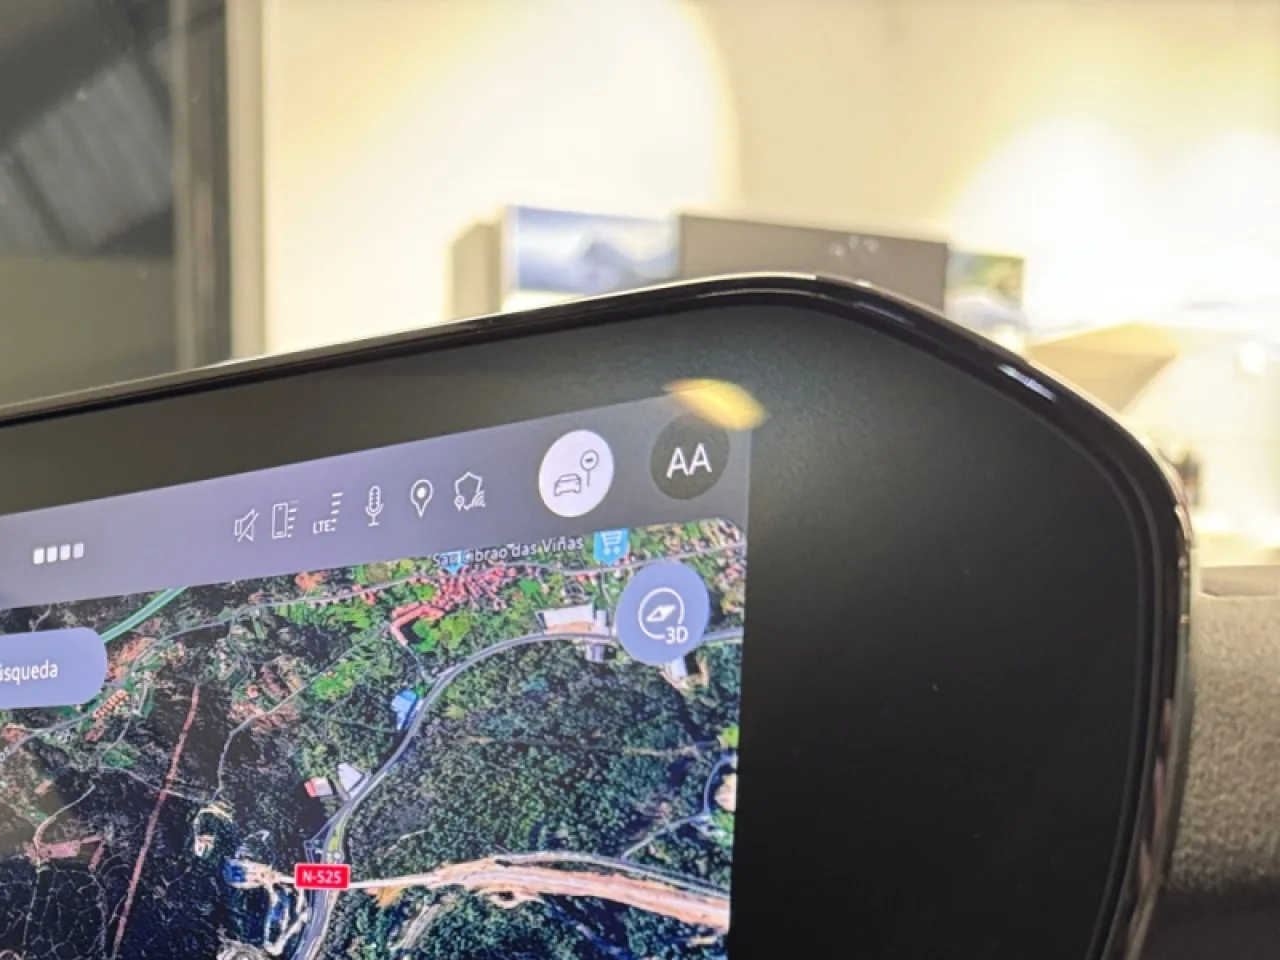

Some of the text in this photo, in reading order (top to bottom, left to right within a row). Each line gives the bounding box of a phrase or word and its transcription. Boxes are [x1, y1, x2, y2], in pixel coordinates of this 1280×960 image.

[665, 442, 713, 480] AA
[312, 519, 331, 535] LTE
[512, 542, 538, 558] das
[541, 535, 586, 553] Viñas
[664, 625, 690, 645] 3D
[301, 868, 343, 886] N-525
